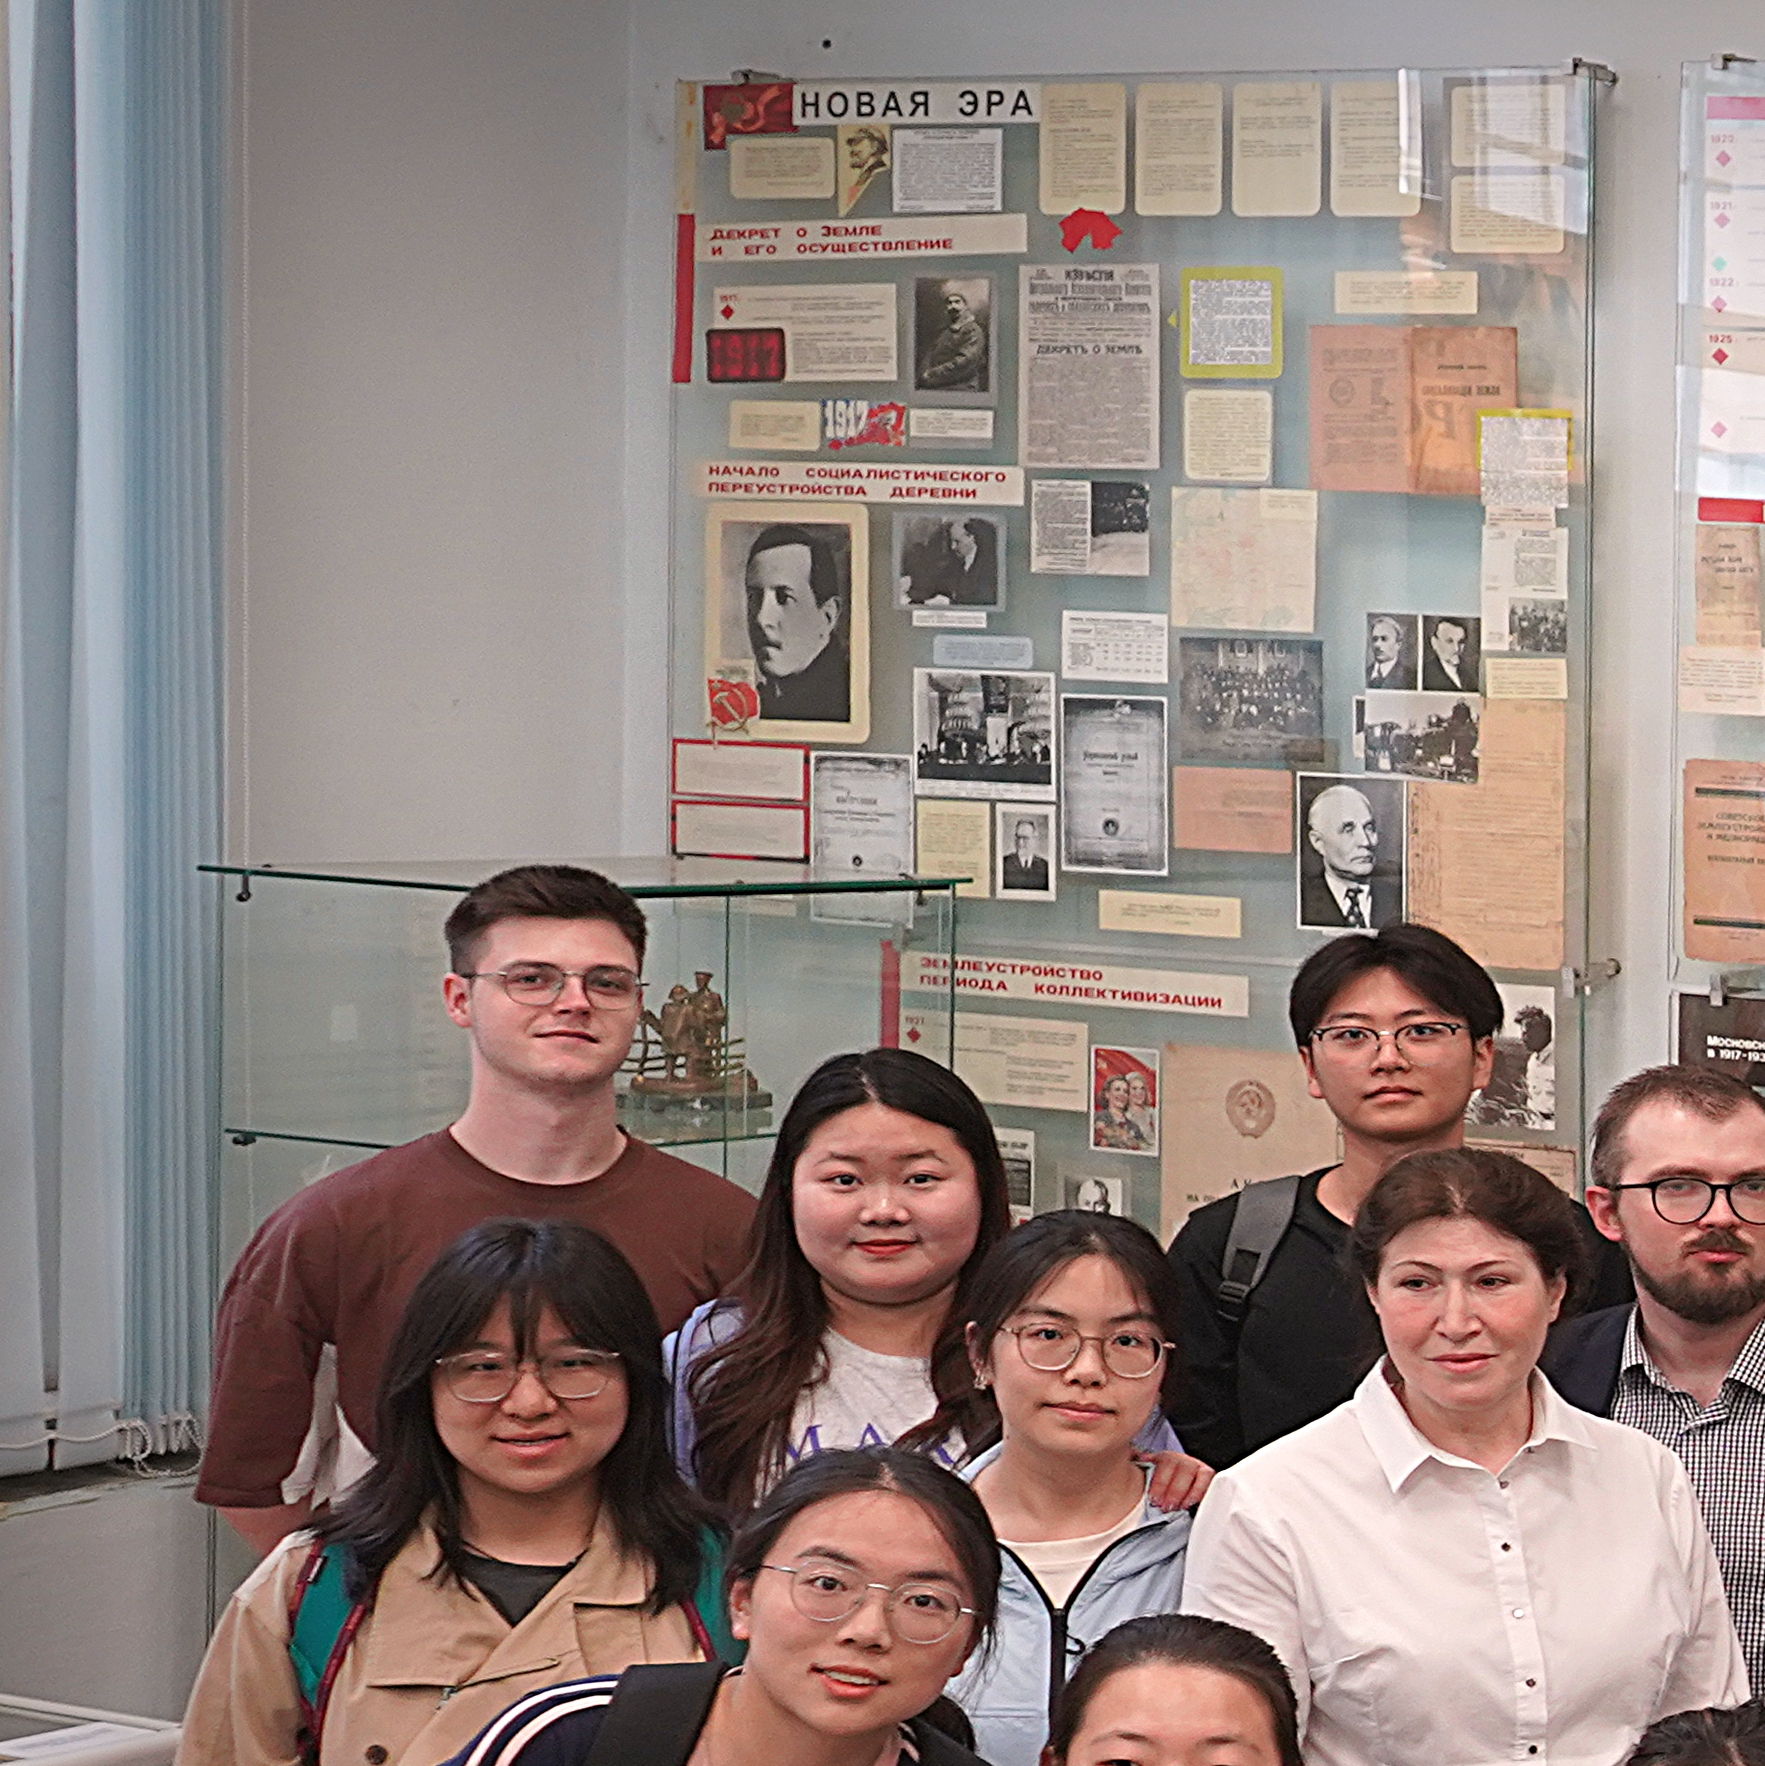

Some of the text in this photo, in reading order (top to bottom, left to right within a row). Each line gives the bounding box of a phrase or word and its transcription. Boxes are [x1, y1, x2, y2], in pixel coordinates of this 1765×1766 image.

[801, 90, 1033, 118] НОВАЯ ЭРА
[709, 225, 883, 241] ДЕКРЕТ О ЗЕМЛЕ
[711, 239, 953, 256] И ЕГО ОСУЩЕСТВЛЕНИЕ
[825, 400, 868, 438] 1917
[709, 465, 1006, 482] НАЧАЛО СОЦИАЛИСТИЧЕСКОГО
[709, 482, 977, 499] ПЕРЕУСТРОЙСТВА ДЕРЕВНИ
[920, 957, 1103, 982] ЗЕМЛЕУСТРОЙСТВО
[919, 974, 1223, 1009] ПЕРИОДА КОЛЛЕКТИВИЗАЦИИ
[1707, 1049, 1715, 1058] в
